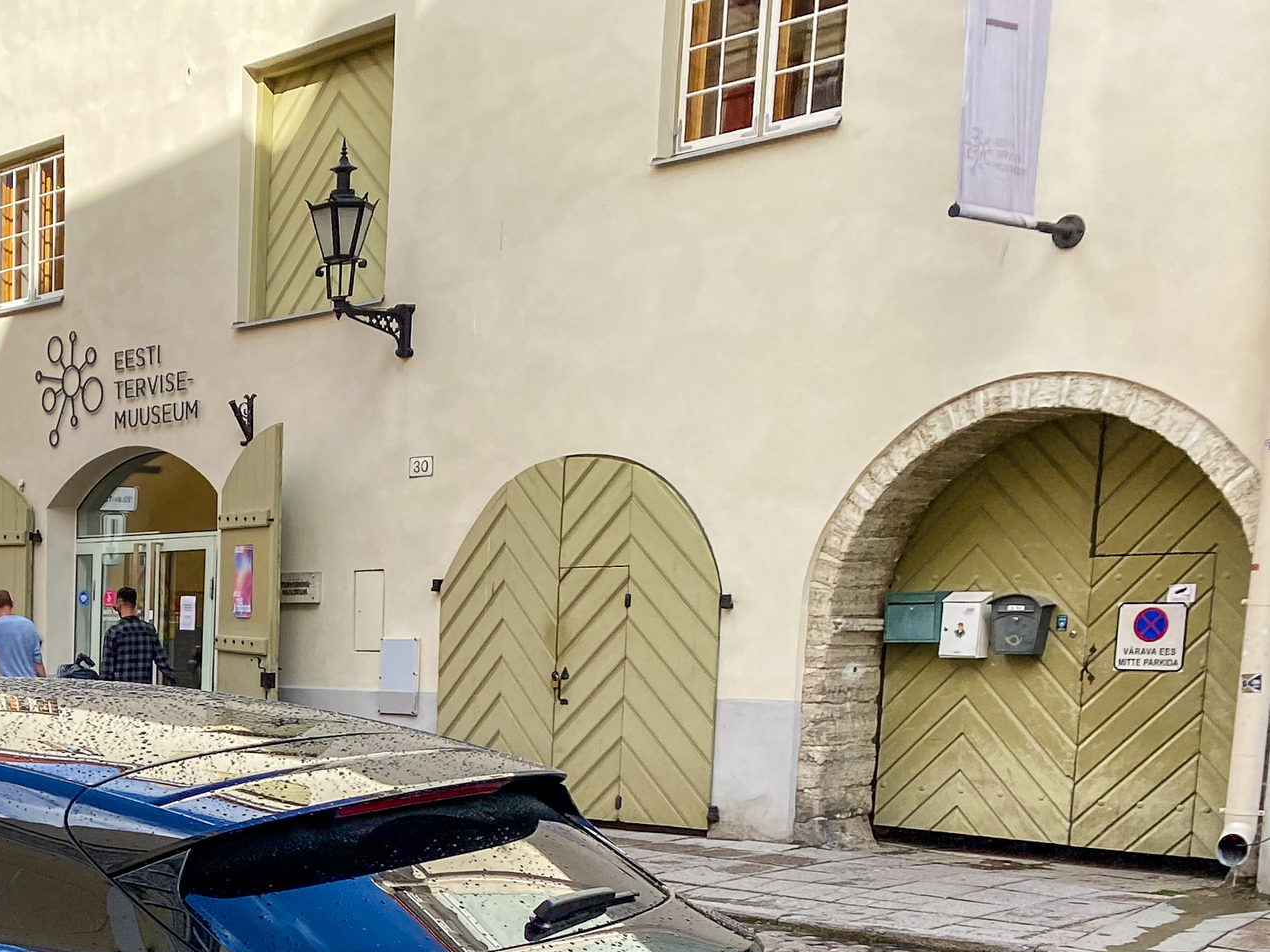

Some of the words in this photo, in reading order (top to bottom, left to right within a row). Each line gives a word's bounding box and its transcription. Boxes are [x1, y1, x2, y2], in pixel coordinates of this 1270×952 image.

[114, 345, 161, 370] EESTI
[114, 371, 193, 399] TERVISE-
[114, 400, 198, 429] MUUSEUM
[413, 460, 428, 473] 30
[1123, 646, 1156, 655] VÄRAVA
[1159, 647, 1177, 656] EES
[1118, 658, 1141, 666] MITTE
[1142, 658, 1178, 667] PARKIDA
